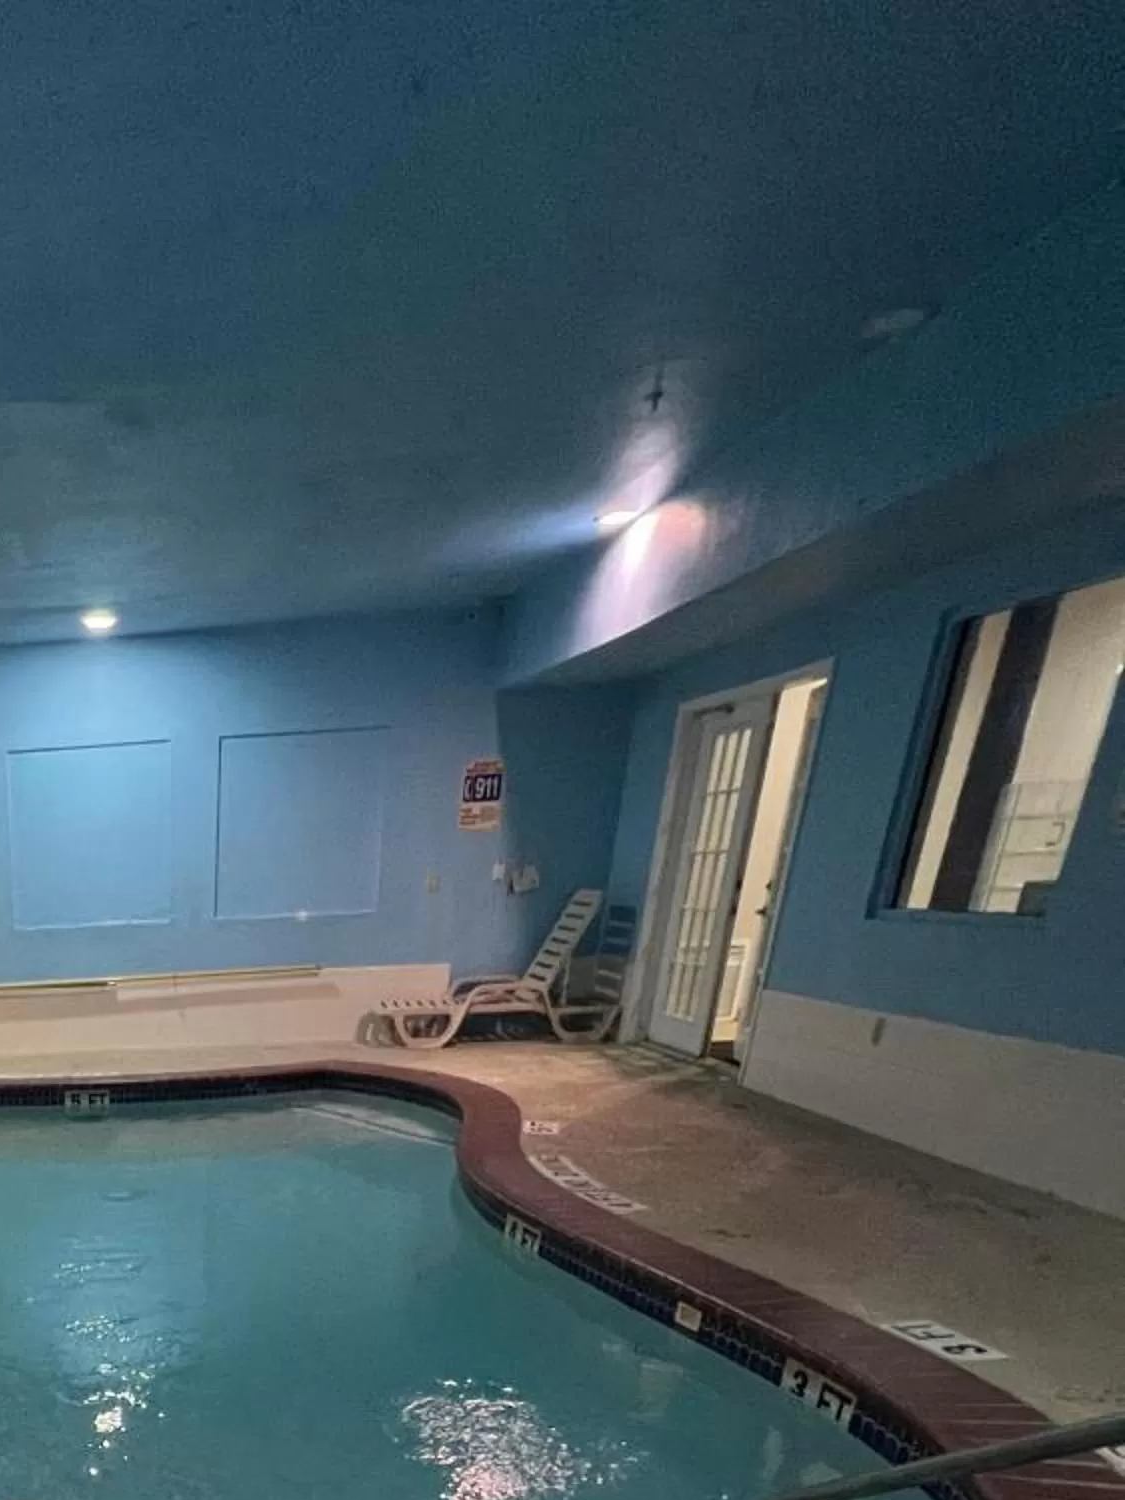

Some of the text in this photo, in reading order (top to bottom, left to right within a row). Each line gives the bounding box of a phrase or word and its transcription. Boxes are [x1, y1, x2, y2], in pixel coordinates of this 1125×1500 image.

[475, 777, 500, 800] 911
[88, 1094, 105, 1105] FT
[520, 1227, 539, 1248] FT
[790, 1370, 852, 1422] 3 FT
